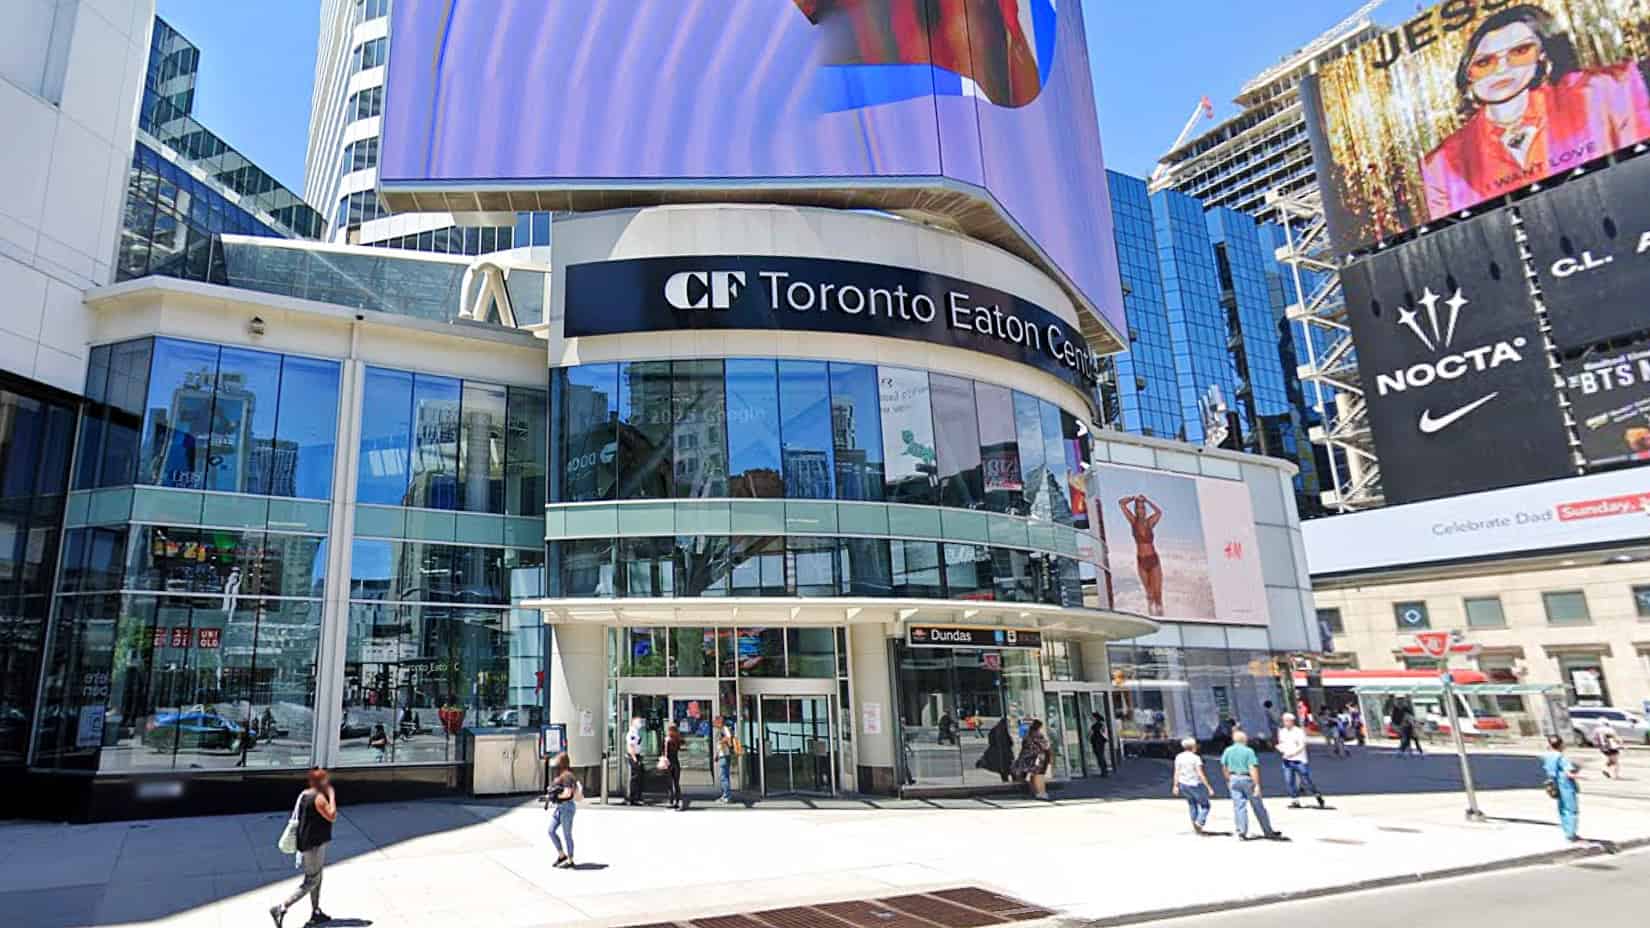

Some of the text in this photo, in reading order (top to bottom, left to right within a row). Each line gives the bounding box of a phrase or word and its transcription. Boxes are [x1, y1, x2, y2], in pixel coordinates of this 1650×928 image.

[1494, 161, 1544, 188] WANT
[1549, 141, 1596, 167] LOVE
[1551, 250, 1614, 277] C.L.
[664, 270, 1098, 378] CF Toronto Eaton Cent
[1580, 363, 1635, 395] BTS
[1431, 514, 1511, 537] Celebrate
[1516, 510, 1553, 525] Dad
[930, 628, 972, 642] Dundas
